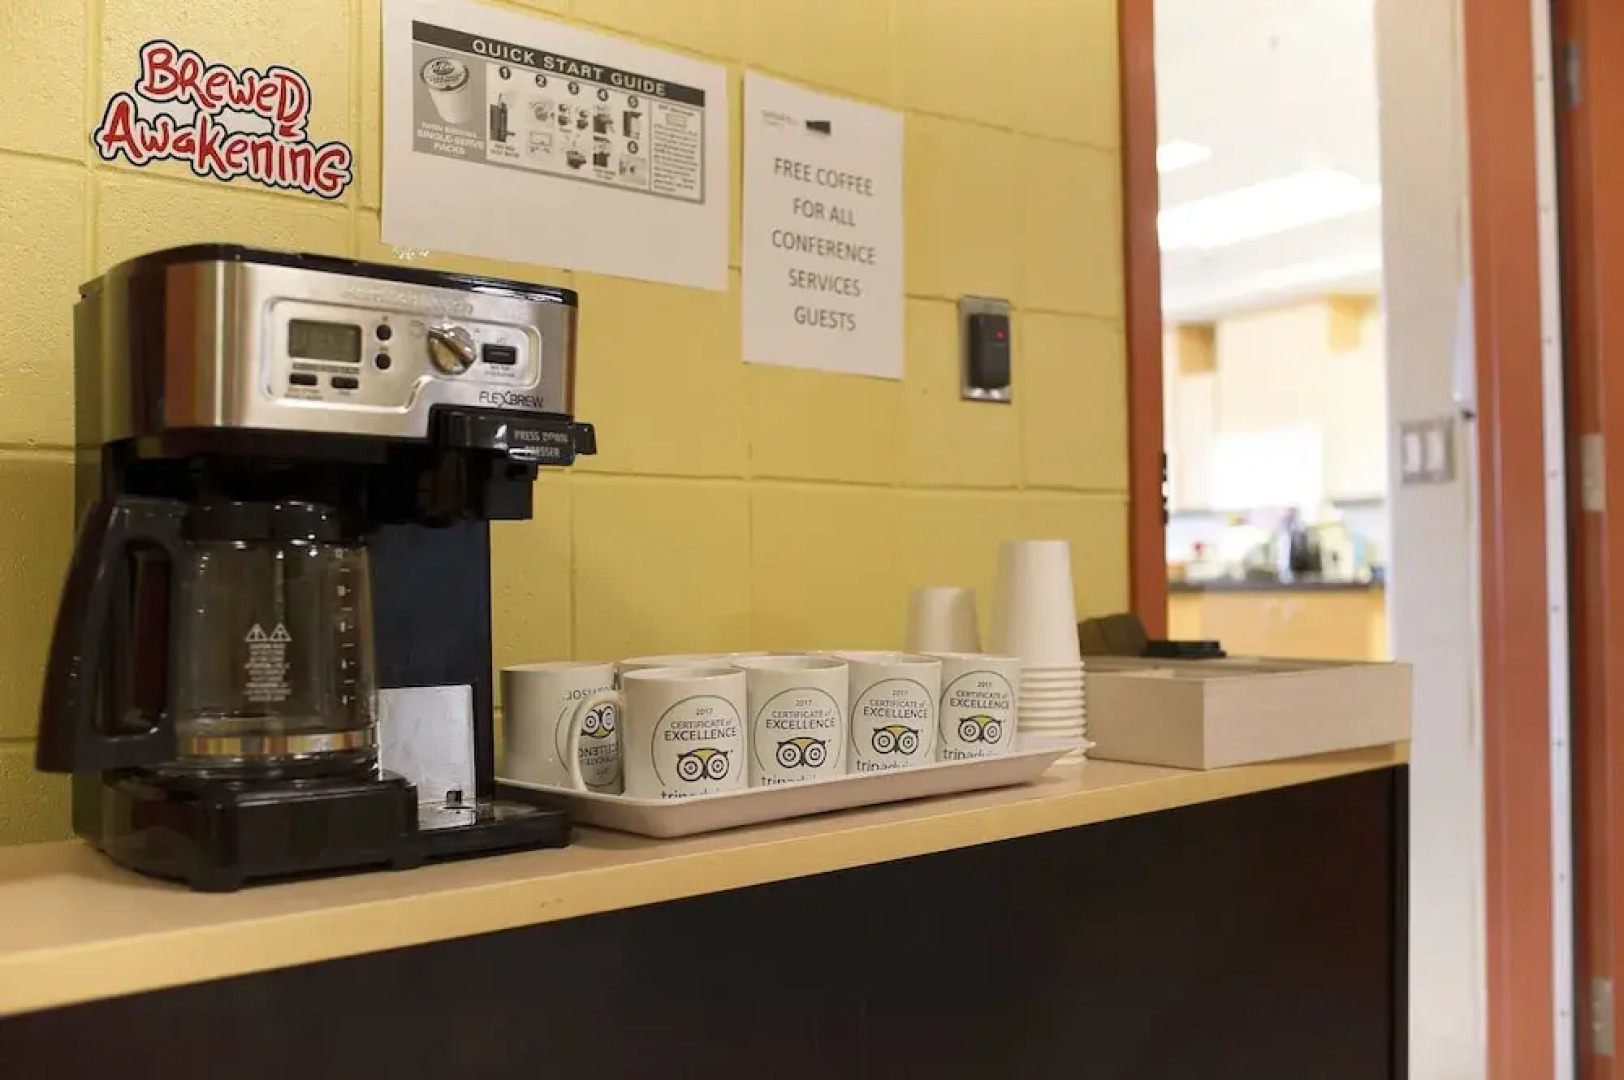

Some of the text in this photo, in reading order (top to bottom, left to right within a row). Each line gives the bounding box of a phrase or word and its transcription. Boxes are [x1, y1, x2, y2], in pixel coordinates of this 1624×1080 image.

[472, 38, 667, 97] QUICK START GUIDE
[774, 157, 874, 197] FREE COFFEE
[793, 198, 856, 227] FOR ALL
[772, 229, 876, 265] CONFERENCE
[788, 268, 861, 297] SERVICES
[794, 306, 856, 332] GUESTS
[956, 690, 1000, 699] CERTIFICATE
[870, 700, 917, 708] CERTIFICATE
[950, 698, 1009, 710] EXCELLENCE
[772, 711, 822, 719] CERTIFICATE
[864, 706, 928, 718] EXCELLENCE
[671, 719, 724, 729] CERTIFICATE
[766, 718, 836, 729] EXCELLENCE
[664, 726, 736, 741] EXCELLENCE
